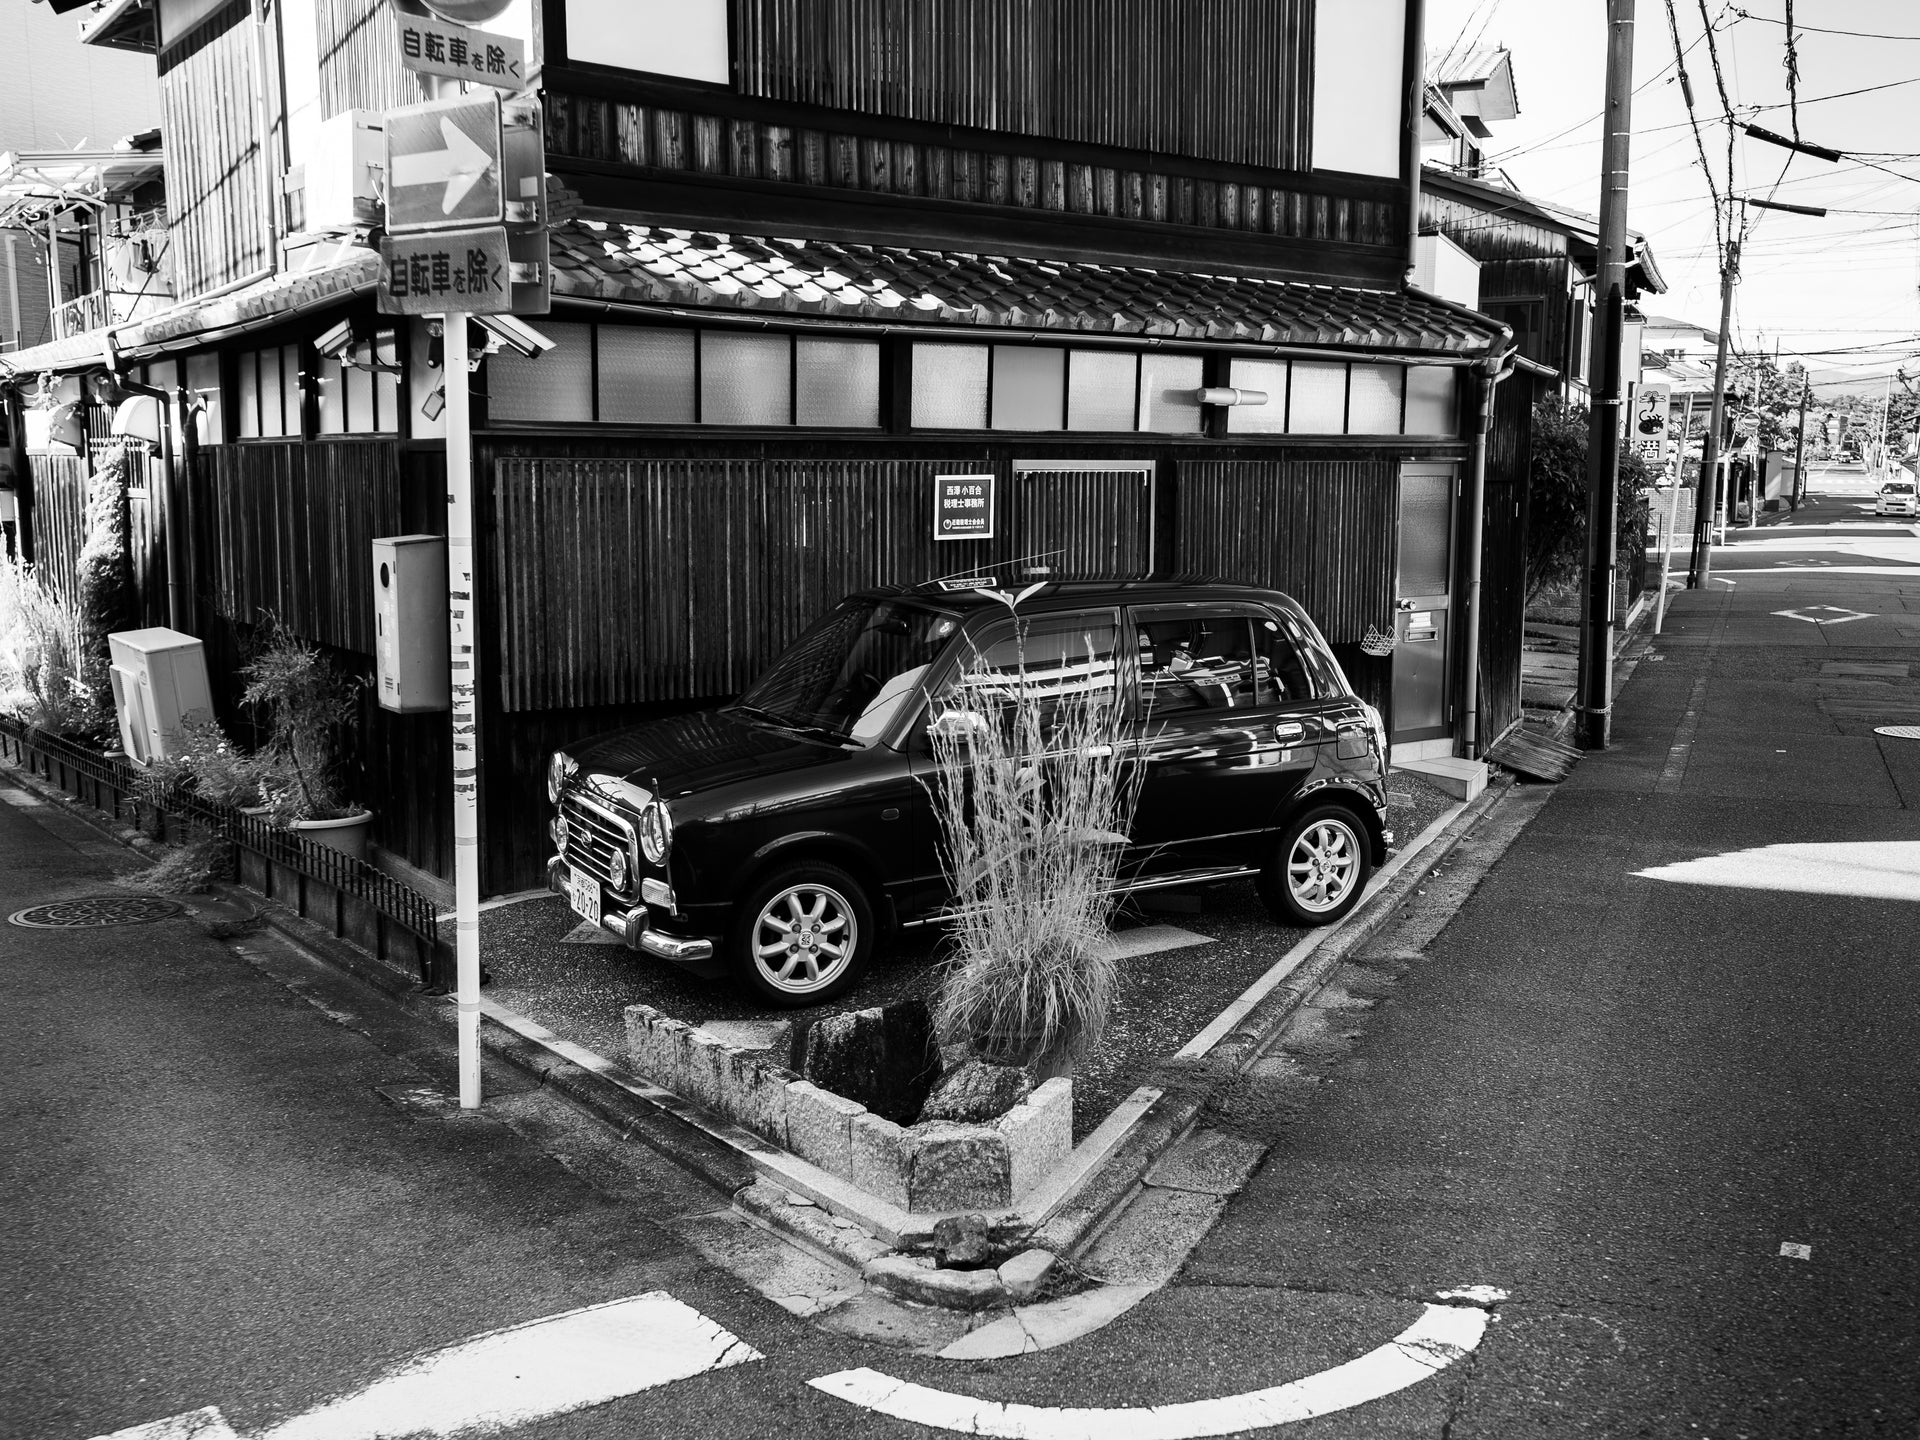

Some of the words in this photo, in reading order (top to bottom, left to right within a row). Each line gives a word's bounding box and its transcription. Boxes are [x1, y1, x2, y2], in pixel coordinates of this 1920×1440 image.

[403, 27, 520, 79] 自転車を除く
[389, 248, 503, 297] 自転車を除く
[943, 498, 985, 509] 税理士事務所
[961, 485, 982, 496] 小百合
[576, 888, 599, 922] 20-20
